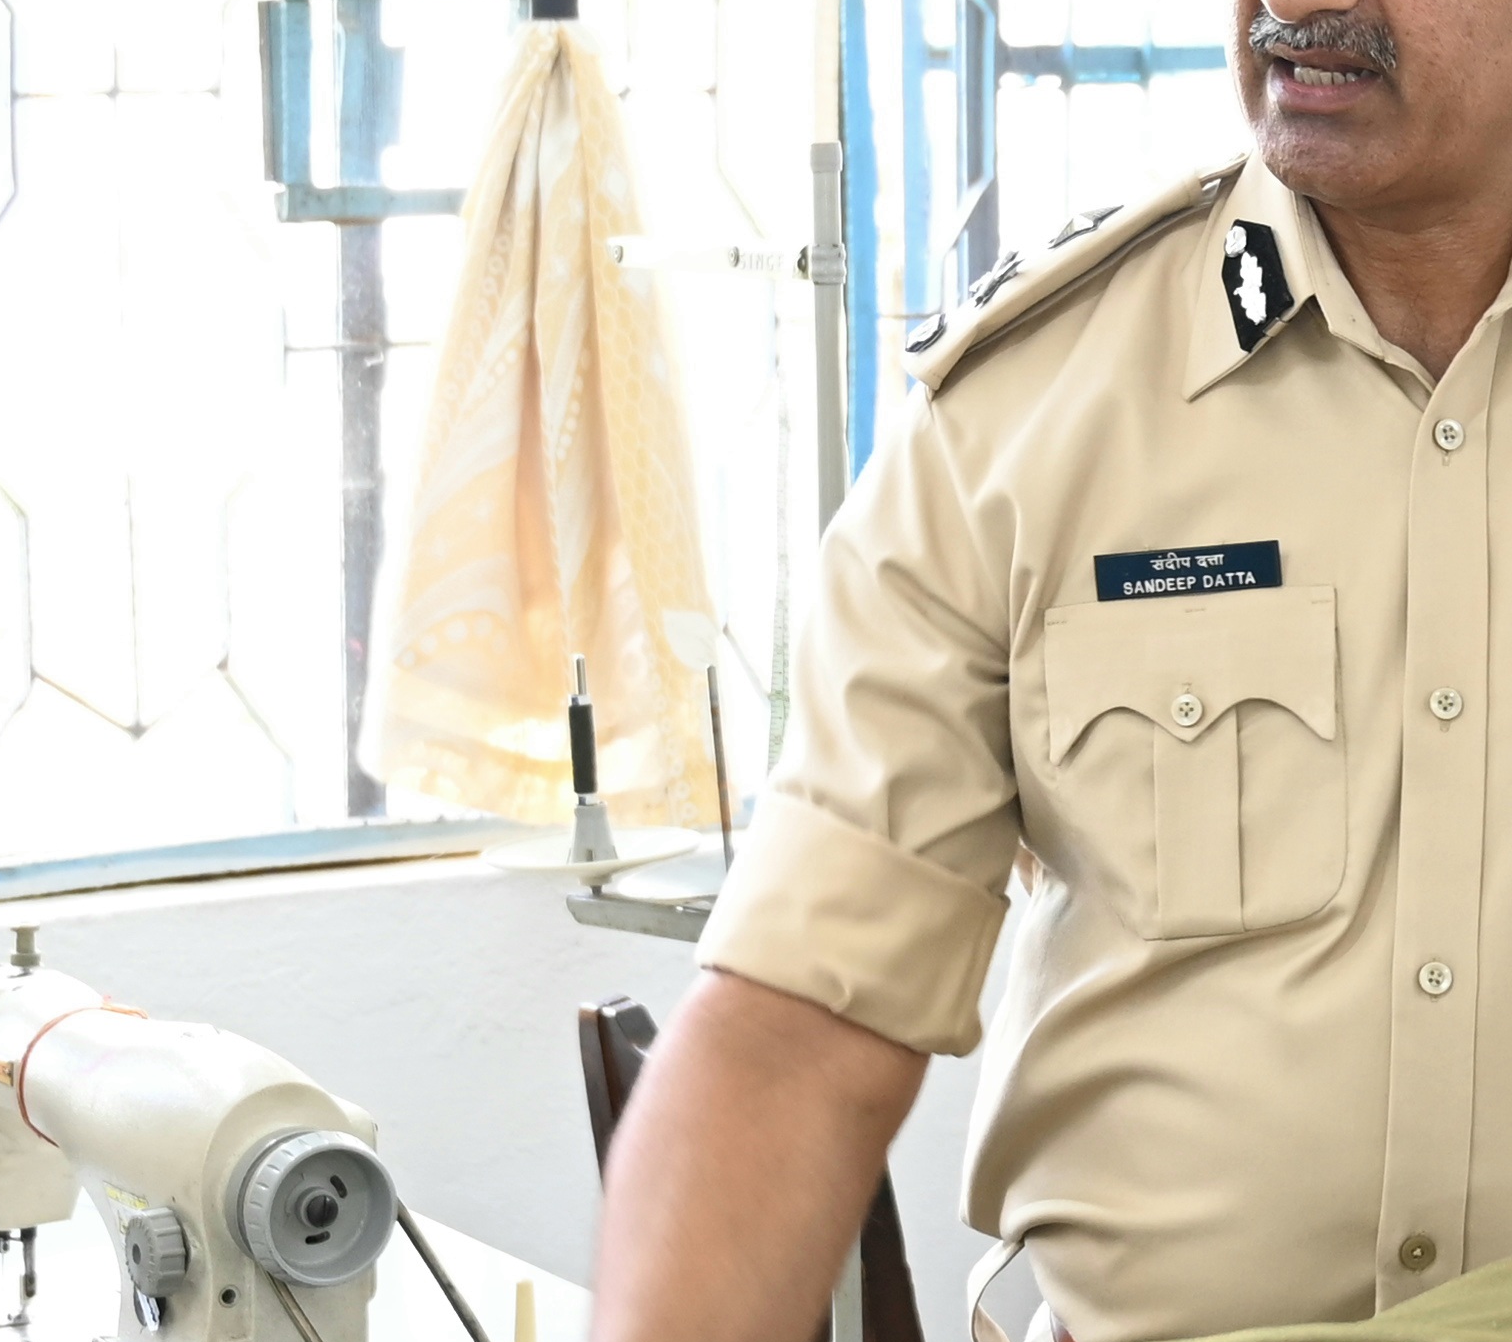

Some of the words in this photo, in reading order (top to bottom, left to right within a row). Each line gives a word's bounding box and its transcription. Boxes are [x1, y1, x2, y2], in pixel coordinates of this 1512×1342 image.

[1150, 552, 1191, 571] संदीप
[1195, 553, 1225, 568] दत्ता
[1123, 576, 1197, 595] SANDEEP
[1203, 571, 1256, 588] DATTA
